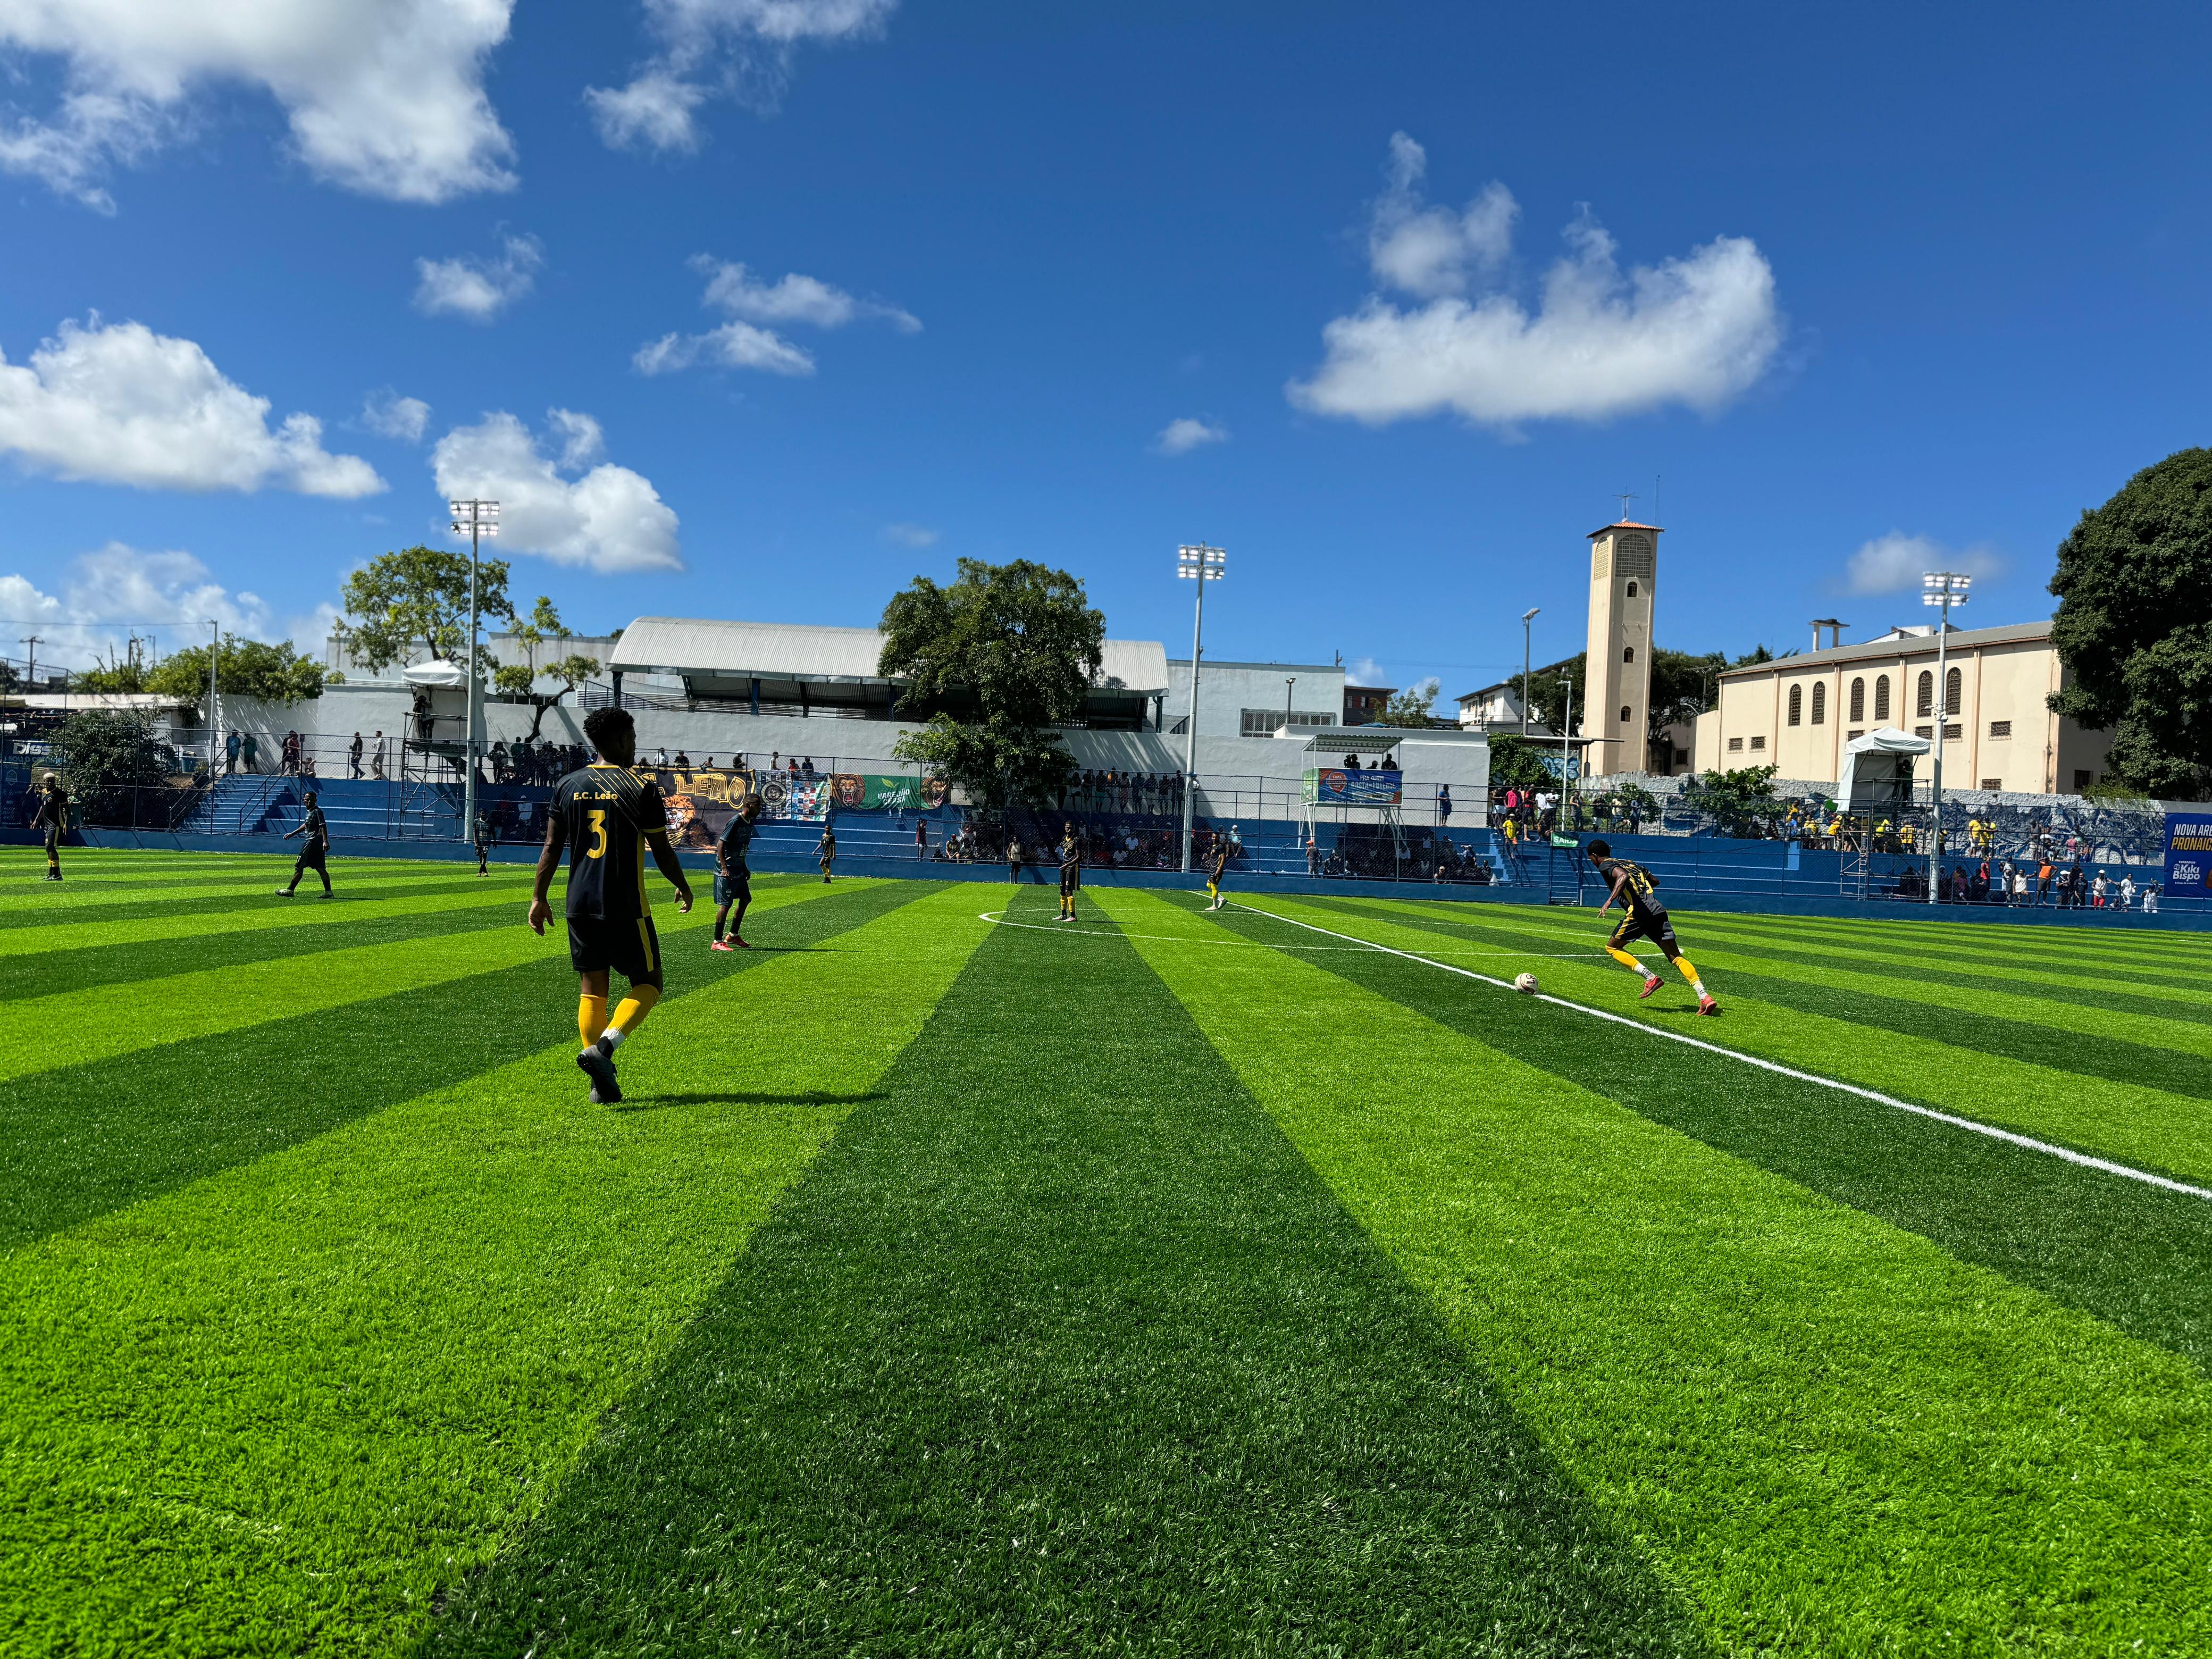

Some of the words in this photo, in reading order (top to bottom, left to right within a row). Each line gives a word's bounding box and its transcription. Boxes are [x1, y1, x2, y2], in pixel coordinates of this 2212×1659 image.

[574, 791, 592, 800] E.C.
[595, 791, 618, 800] Leão
[673, 773, 746, 809] LEÃO
[586, 809, 607, 859] 3
[2174, 824, 2197, 835] NOVA
[2180, 864, 2200, 874] Kiki
[2173, 870, 2200, 882] Bispo
